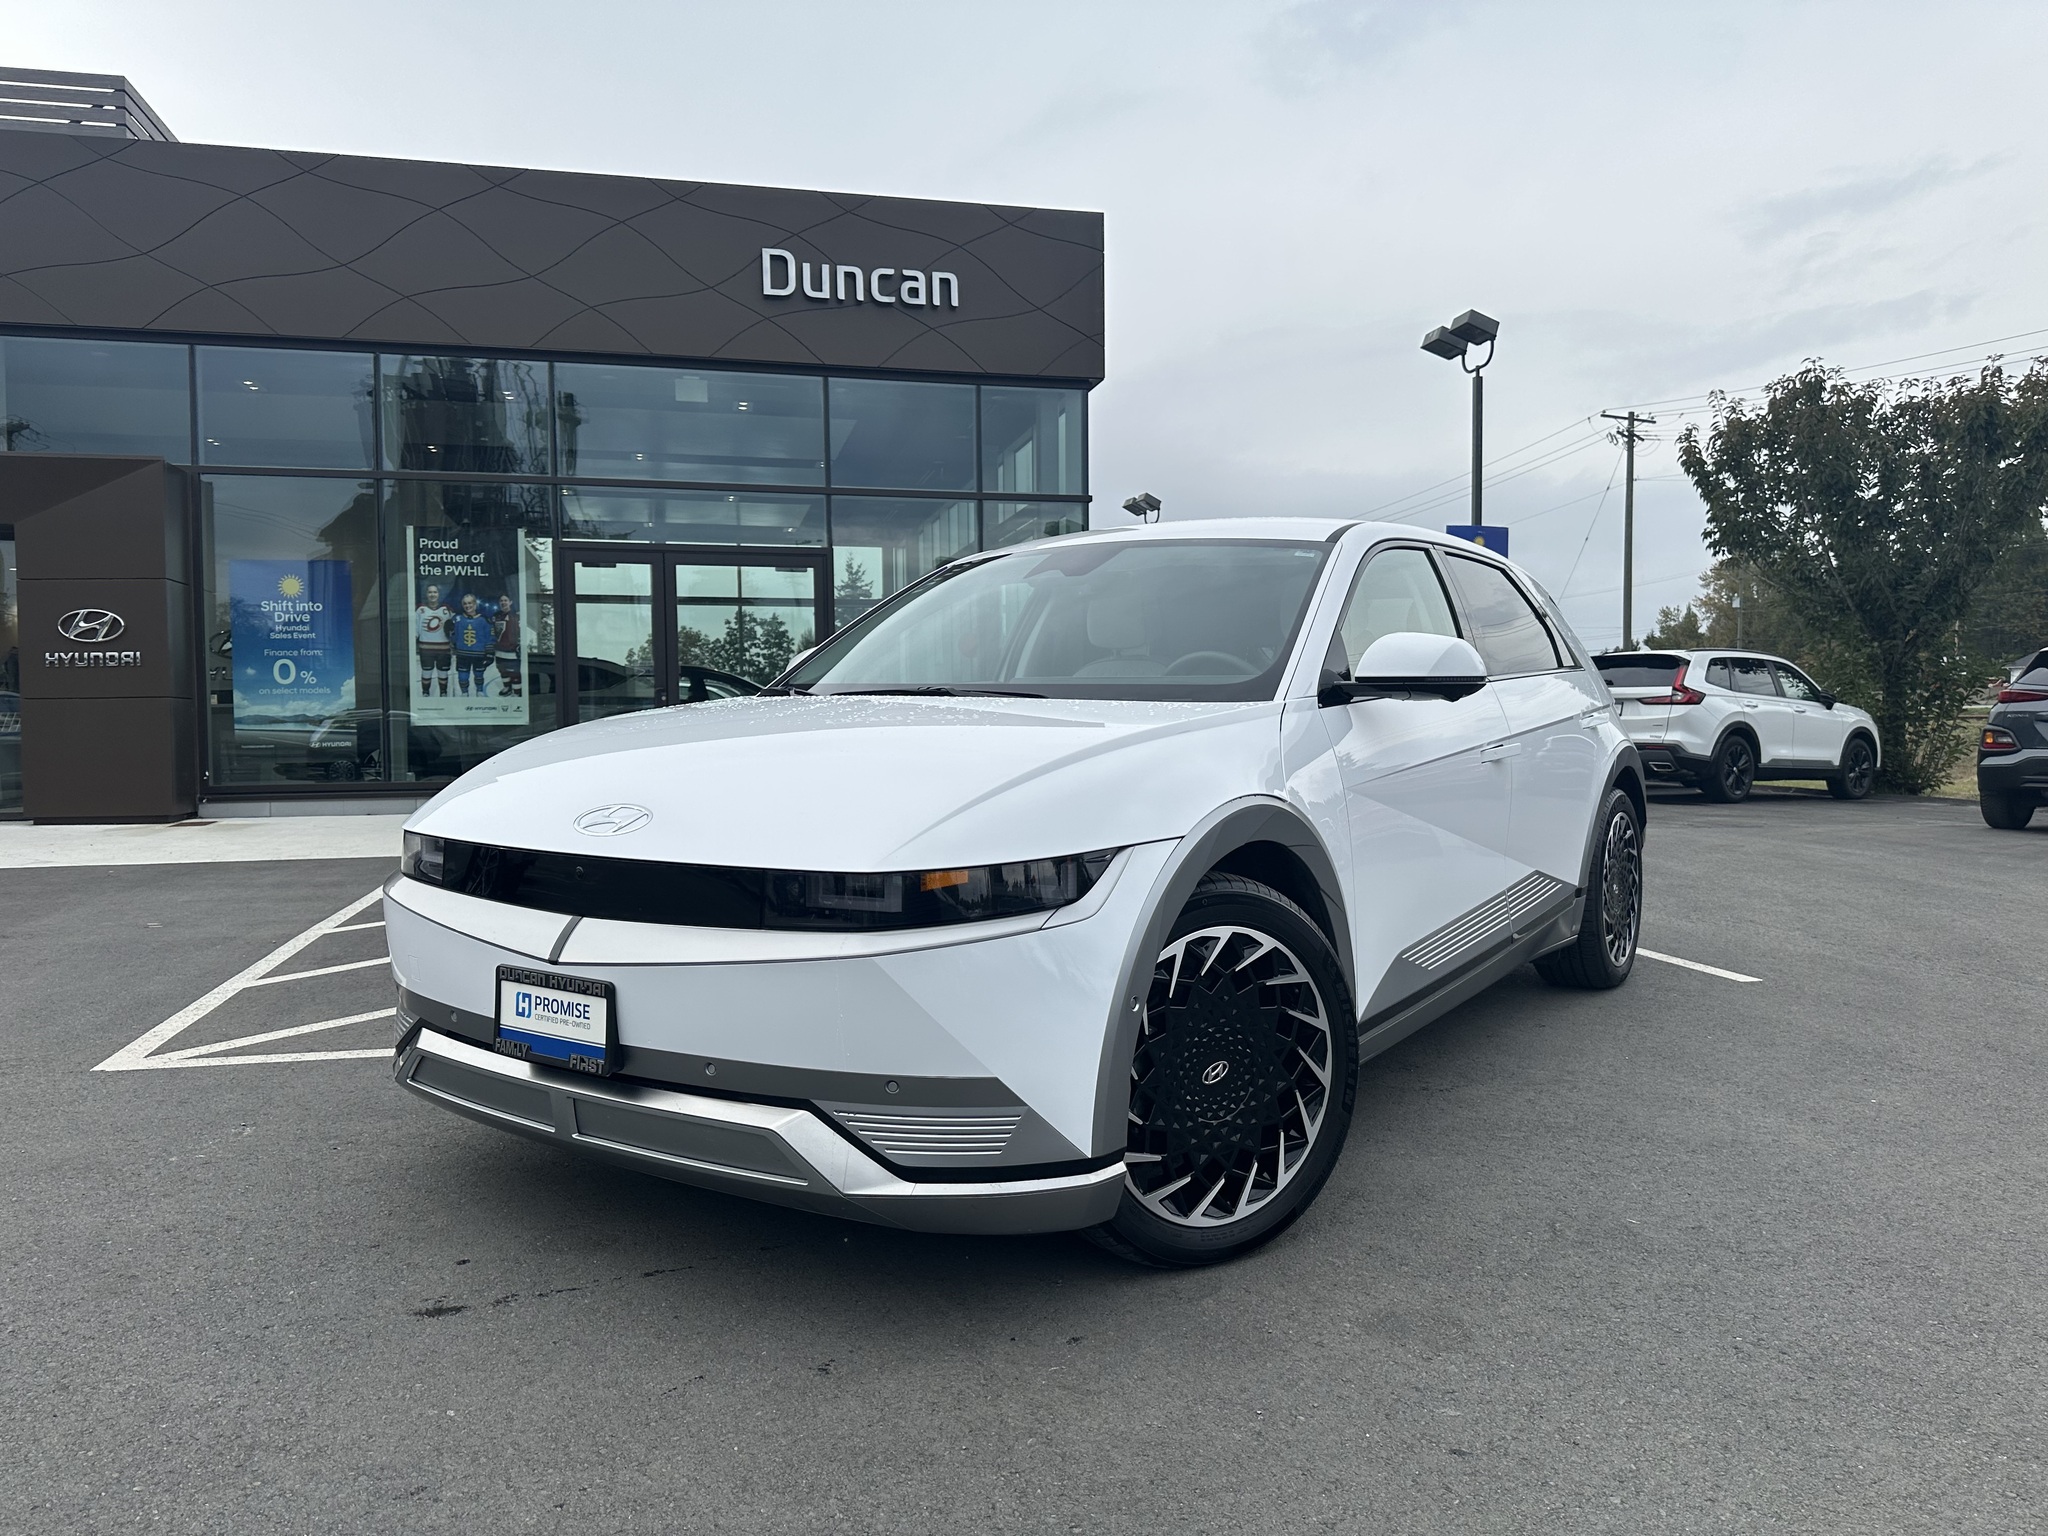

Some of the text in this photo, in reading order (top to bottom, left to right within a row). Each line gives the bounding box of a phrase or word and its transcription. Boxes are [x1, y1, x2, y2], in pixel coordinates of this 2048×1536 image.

[762, 248, 959, 307] Duncan
[419, 538, 459, 550] Proud
[419, 552, 486, 564] partner of
[419, 565, 489, 577] the PWHL.
[260, 600, 323, 611] Shift into
[274, 611, 311, 622] Drive
[275, 624, 310, 633] Hyundai
[269, 632, 316, 640] Sales Event
[263, 648, 323, 657] Finance from:
[45, 652, 141, 667] HYUNDAI
[272, 686, 298, 695] select
[299, 686, 331, 695] models
[500, 968, 606, 997] DUNCAN HYUNDAI
[534, 995, 591, 1020] PROMISE
[535, 1014, 590, 1030] CERTIFIED PRE-OWNED
[1335, 981, 1358, 1110] MICHELIN
[495, 1038, 605, 1074] FAMILY FIRST
